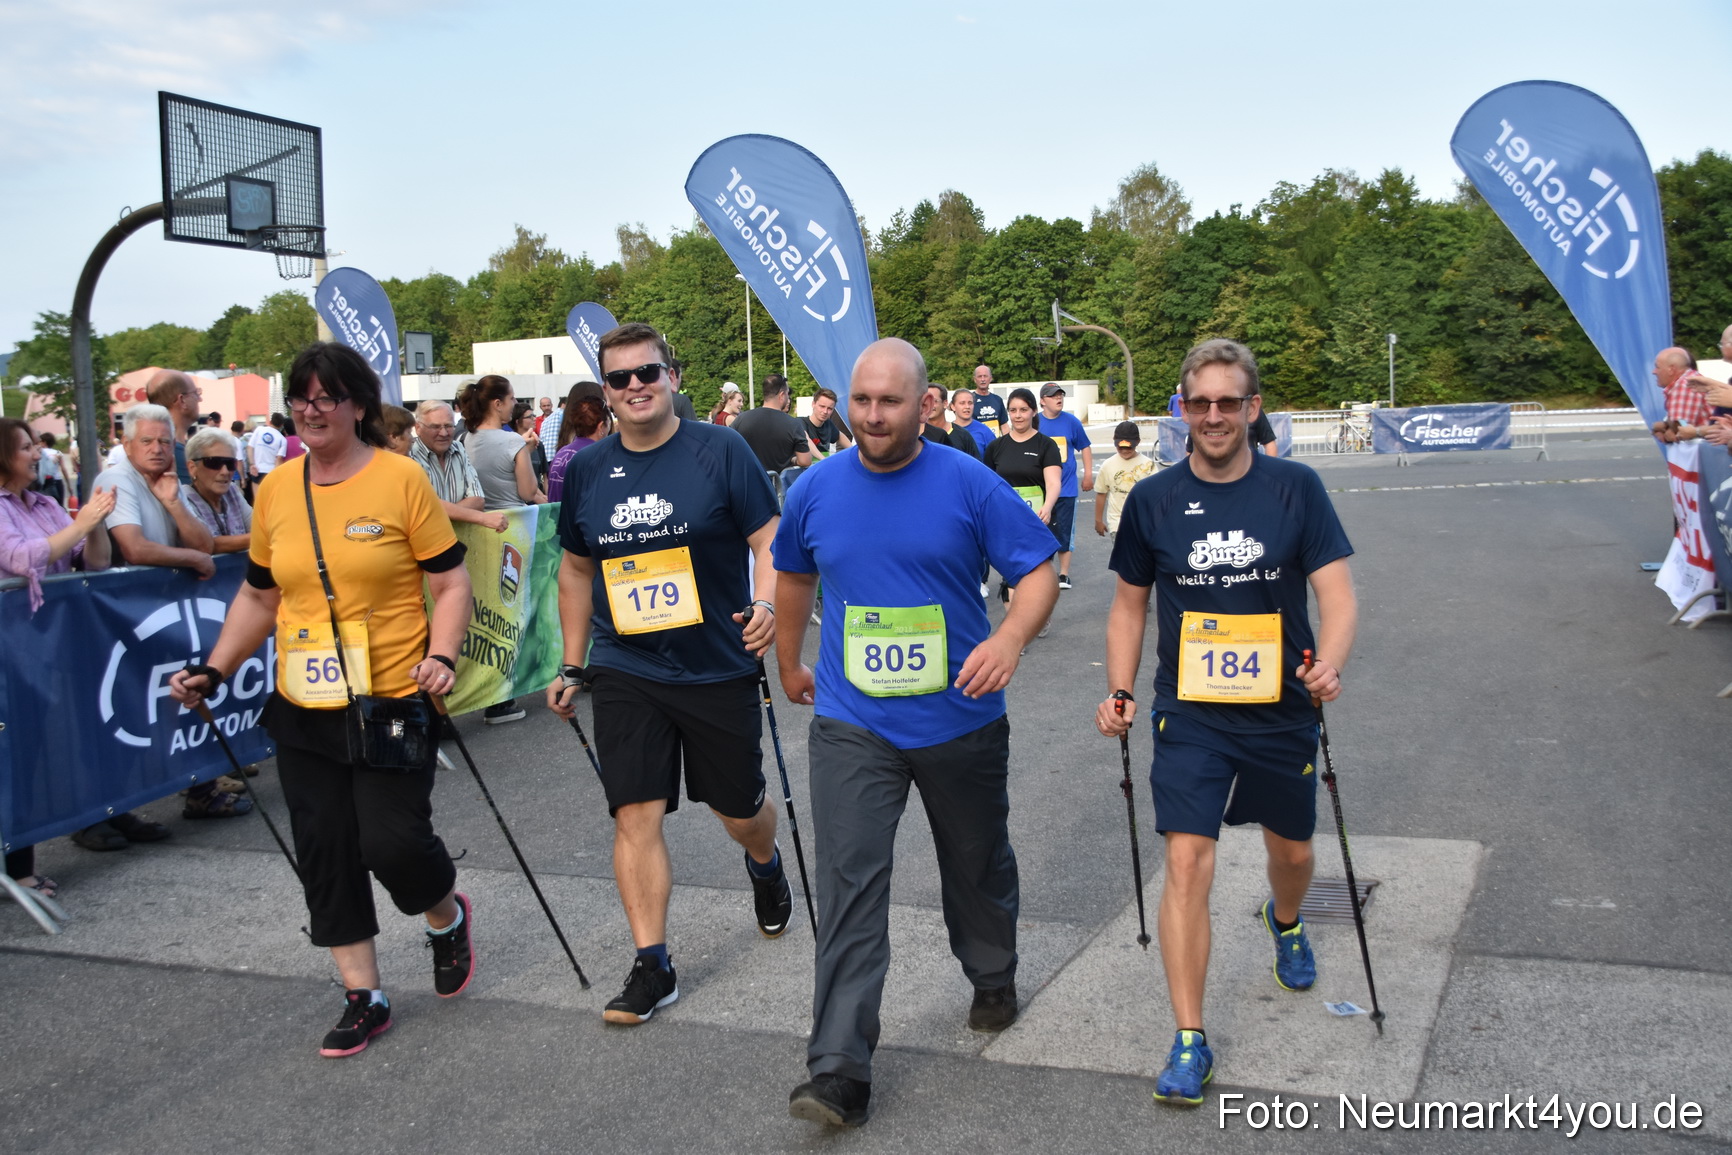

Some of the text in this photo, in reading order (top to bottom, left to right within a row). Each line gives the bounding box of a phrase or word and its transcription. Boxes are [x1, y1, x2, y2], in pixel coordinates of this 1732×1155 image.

[1415, 424, 1482, 439] Fischer
[1421, 437, 1477, 446] AUTOMOBILE
[610, 498, 673, 530] Burgis
[598, 522, 688, 545] Weil's guad is!
[1188, 537, 1263, 571] Burgis
[1176, 567, 1280, 588] Weil's guad is!
[628, 582, 679, 612] 179
[306, 657, 340, 683] 56
[865, 643, 926, 672] 805
[1201, 650, 1261, 678] 184
